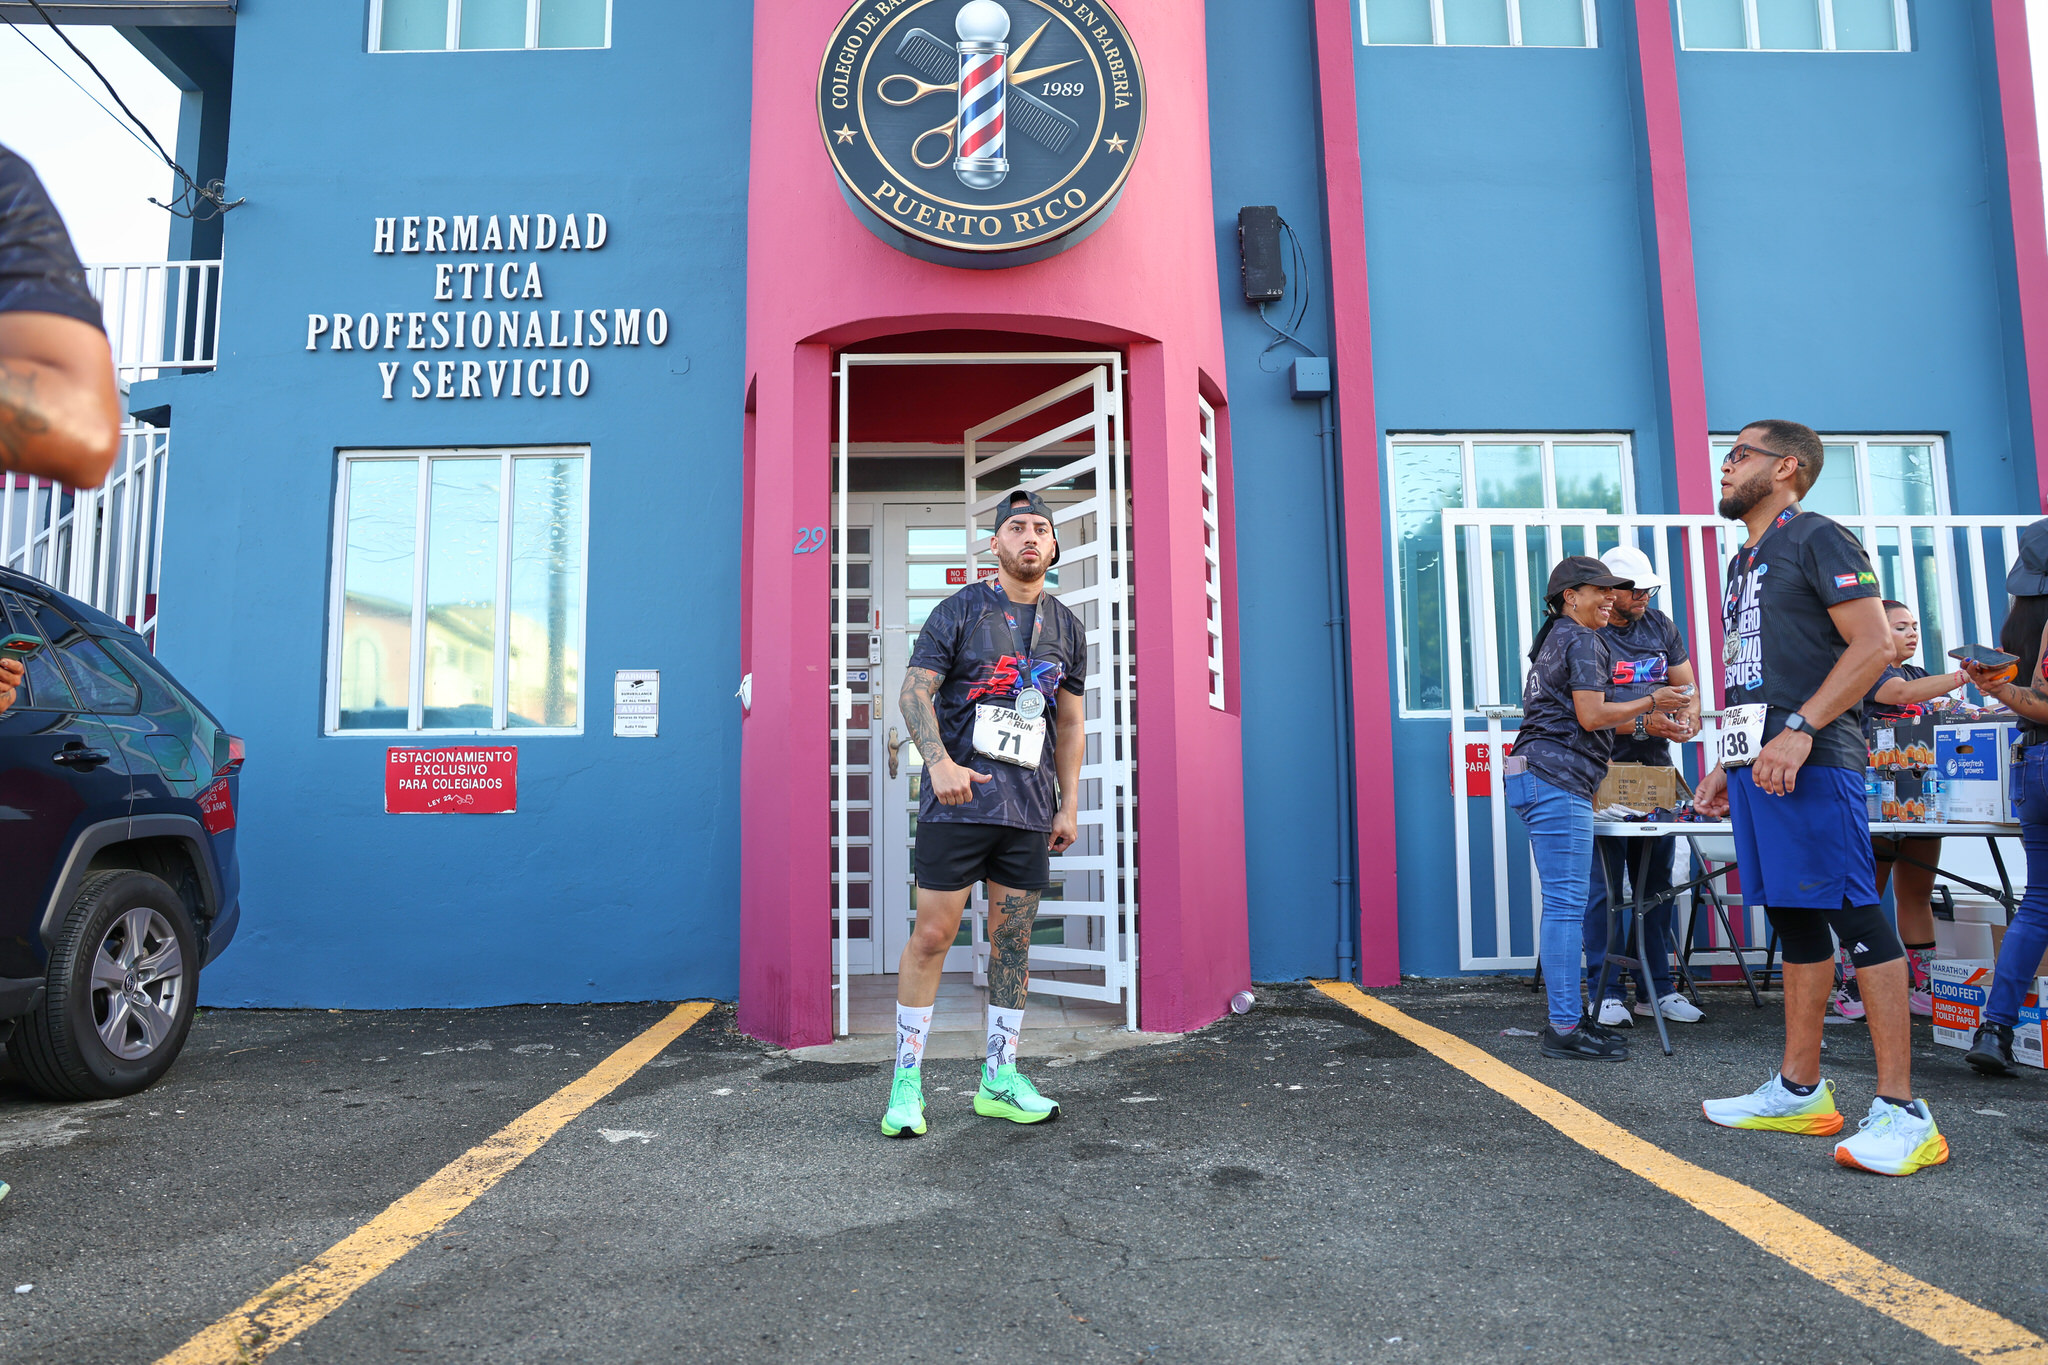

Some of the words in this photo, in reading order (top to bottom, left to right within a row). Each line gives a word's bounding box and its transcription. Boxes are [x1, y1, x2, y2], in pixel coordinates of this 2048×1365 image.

[832, 35, 863, 109] COLEGIO
[855, 12, 880, 36] DE
[1073, 3, 1099, 27] EN
[1092, 25, 1133, 109] BARBERÍA
[1040, 82, 1084, 97] 1989
[871, 180, 1002, 236] PUERTO
[1011, 188, 1087, 234] RICO
[373, 213, 608, 254] HERMANDAD
[434, 261, 544, 300] ETICA
[306, 308, 668, 351] PROFESIONALISMO
[379, 361, 399, 399] Y
[411, 358, 590, 399] SERVICIO
[793, 526, 827, 555] 29
[1612, 656, 1660, 684] 5K
[622, 705, 651, 713] AVISO
[1002, 710, 1024, 723] FAD
[1013, 720, 1034, 731] RUN
[1732, 716, 1749, 726] RUN
[998, 729, 1021, 755] 71
[1722, 731, 1749, 757] 138
[391, 751, 512, 763] ESTACIONAMIENTO
[1958, 760, 1984, 768] superfresh
[414, 764, 488, 775] EXCLUSIVO
[399, 779, 428, 790] PARA
[432, 778, 503, 790] COLEGIADOS
[427, 797, 441, 808] LEY
[1932, 963, 1969, 976] MARATHON
[1934, 983, 1958, 997] 6,000
[1959, 988, 1981, 1001] FEET
[1935, 1002, 1957, 1013] JUMBO
[1957, 1006, 1975, 1017] 2-PLY
[2020, 1010, 2039, 1020] ROLLS
[1935, 1011, 1955, 1022] TOILET
[1956, 1015, 1977, 1026] PAPER
